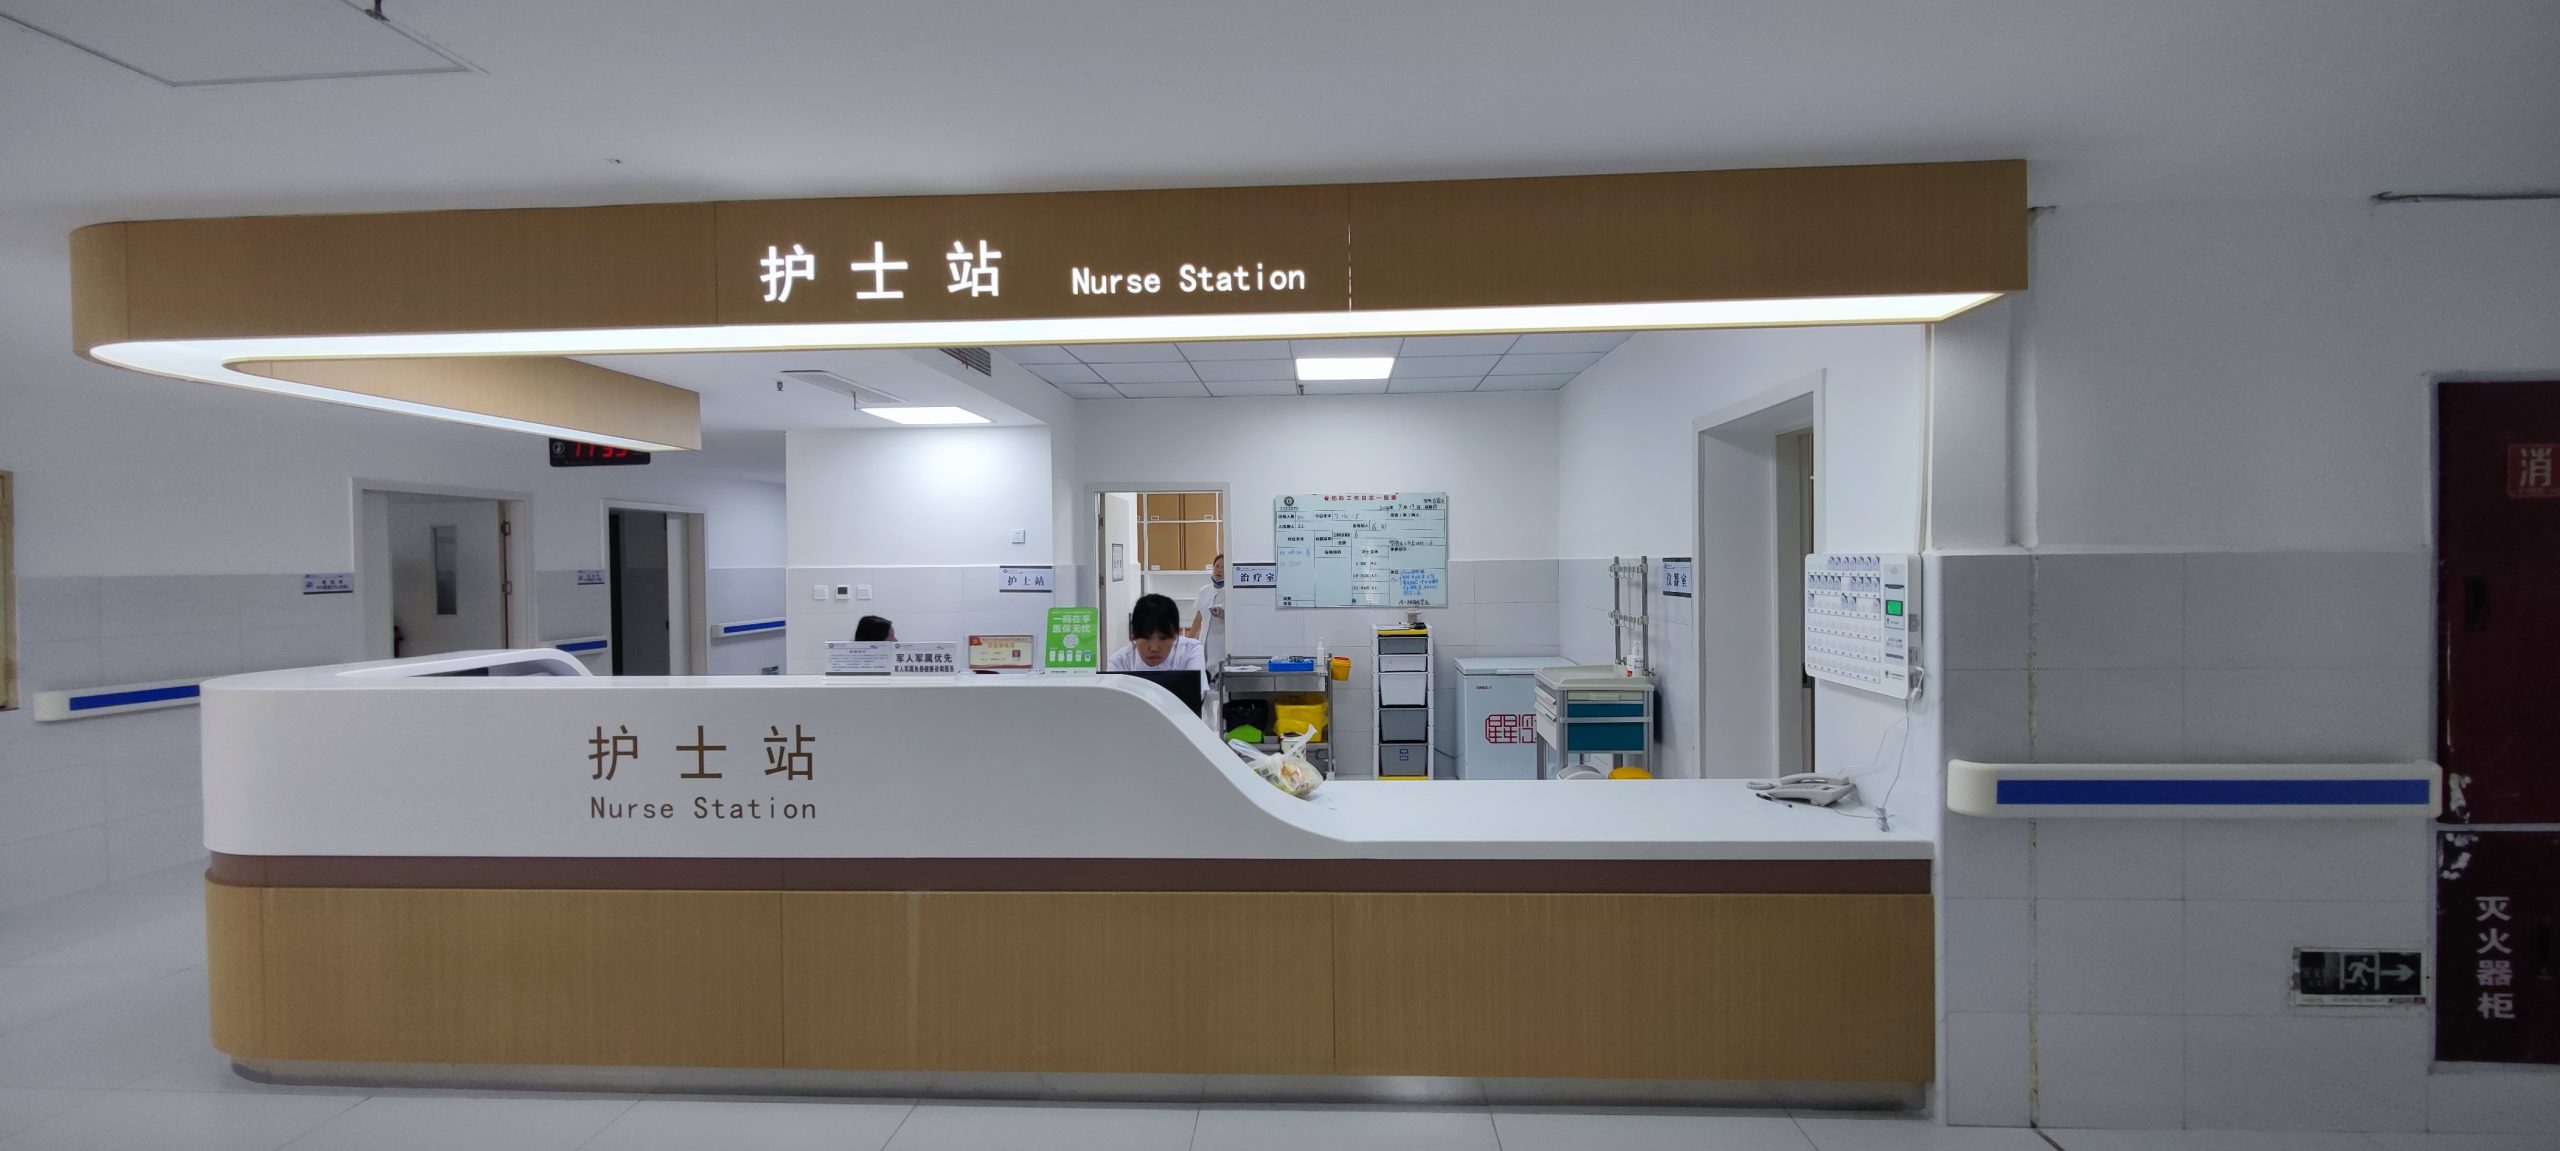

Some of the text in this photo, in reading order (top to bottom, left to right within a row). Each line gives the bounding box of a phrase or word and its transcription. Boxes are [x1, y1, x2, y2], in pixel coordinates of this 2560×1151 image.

[759, 239, 1307, 304] 护士站 Nurse Station
[1007, 575, 1045, 586] 护士站
[1240, 572, 1275, 582] 治疗室
[1665, 572, 1688, 588] 仪器室
[1052, 614, 1091, 624] 一码在手
[1052, 624, 1091, 634] 医保无忧
[895, 652, 953, 664] 军人军属优先
[588, 724, 816, 781] 护士站
[591, 796, 816, 819] Nurse Station
[2475, 896, 2516, 1019] 灭火器柜
